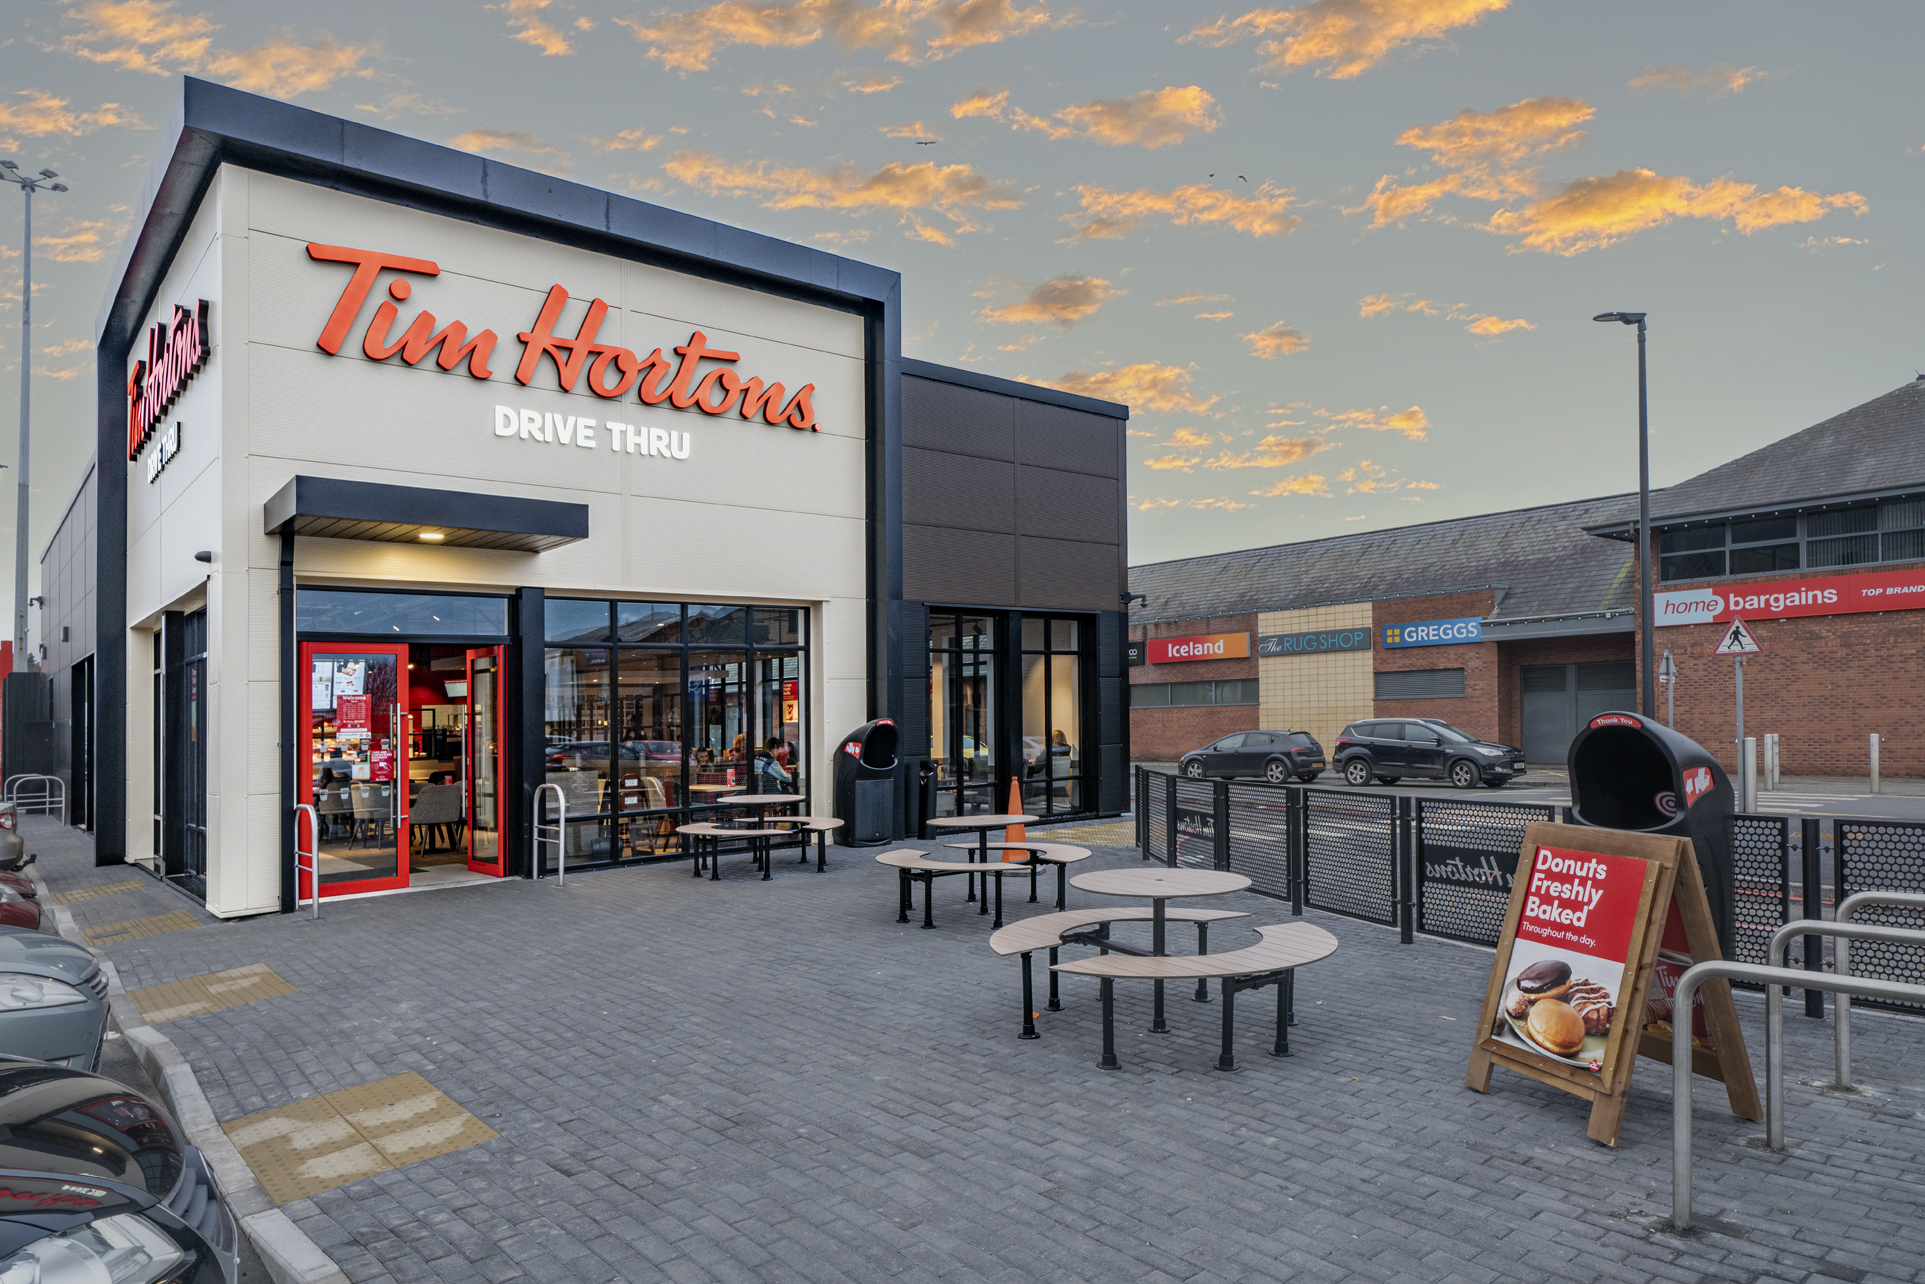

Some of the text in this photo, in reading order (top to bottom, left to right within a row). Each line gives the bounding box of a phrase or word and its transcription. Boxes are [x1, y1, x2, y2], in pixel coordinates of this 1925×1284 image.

[306, 241, 498, 380] Tim
[494, 404, 691, 460] DRIVE THRU
[147, 420, 181, 485] DRIVE THRU
[1664, 587, 1838, 614] home bargains
[1861, 588, 1883, 597] TOP
[1258, 631, 1364, 654] The RUG SHOP
[1404, 622, 1478, 642] GREGGS
[1168, 639, 1224, 658] Iceland
[1597, 717, 1633, 725] Thank You
[1536, 849, 1607, 880] Donuts
[1530, 872, 1604, 910] Freshly
[1525, 895, 1589, 928] Baked
[1522, 921, 1596, 948] Throughout the day.
